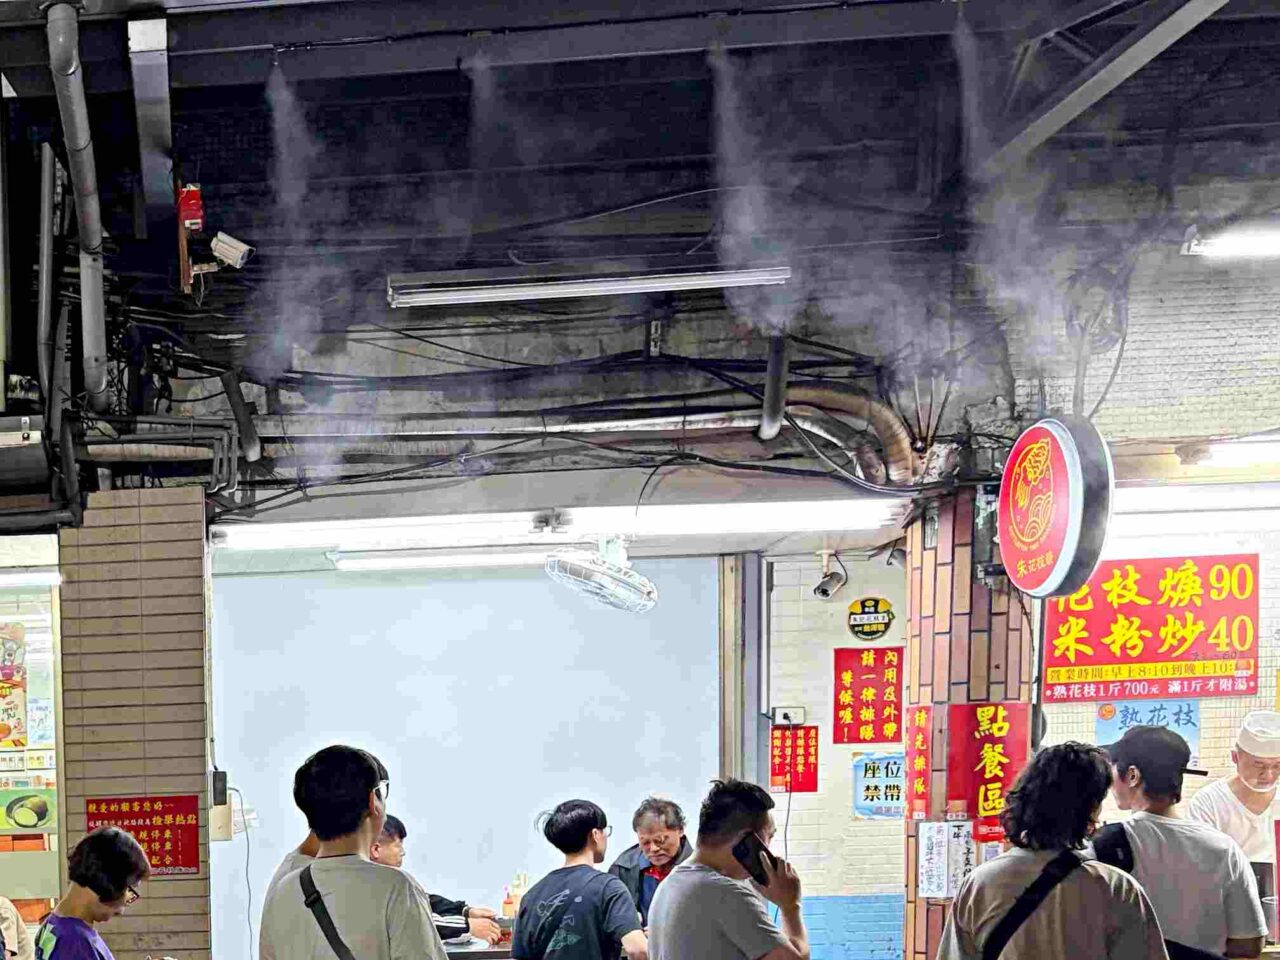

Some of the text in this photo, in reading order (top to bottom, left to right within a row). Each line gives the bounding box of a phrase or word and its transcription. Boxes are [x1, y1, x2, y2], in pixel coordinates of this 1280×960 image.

[859, 649, 877, 741] 請一律排隊
[974, 705, 1010, 817] 點餐區
